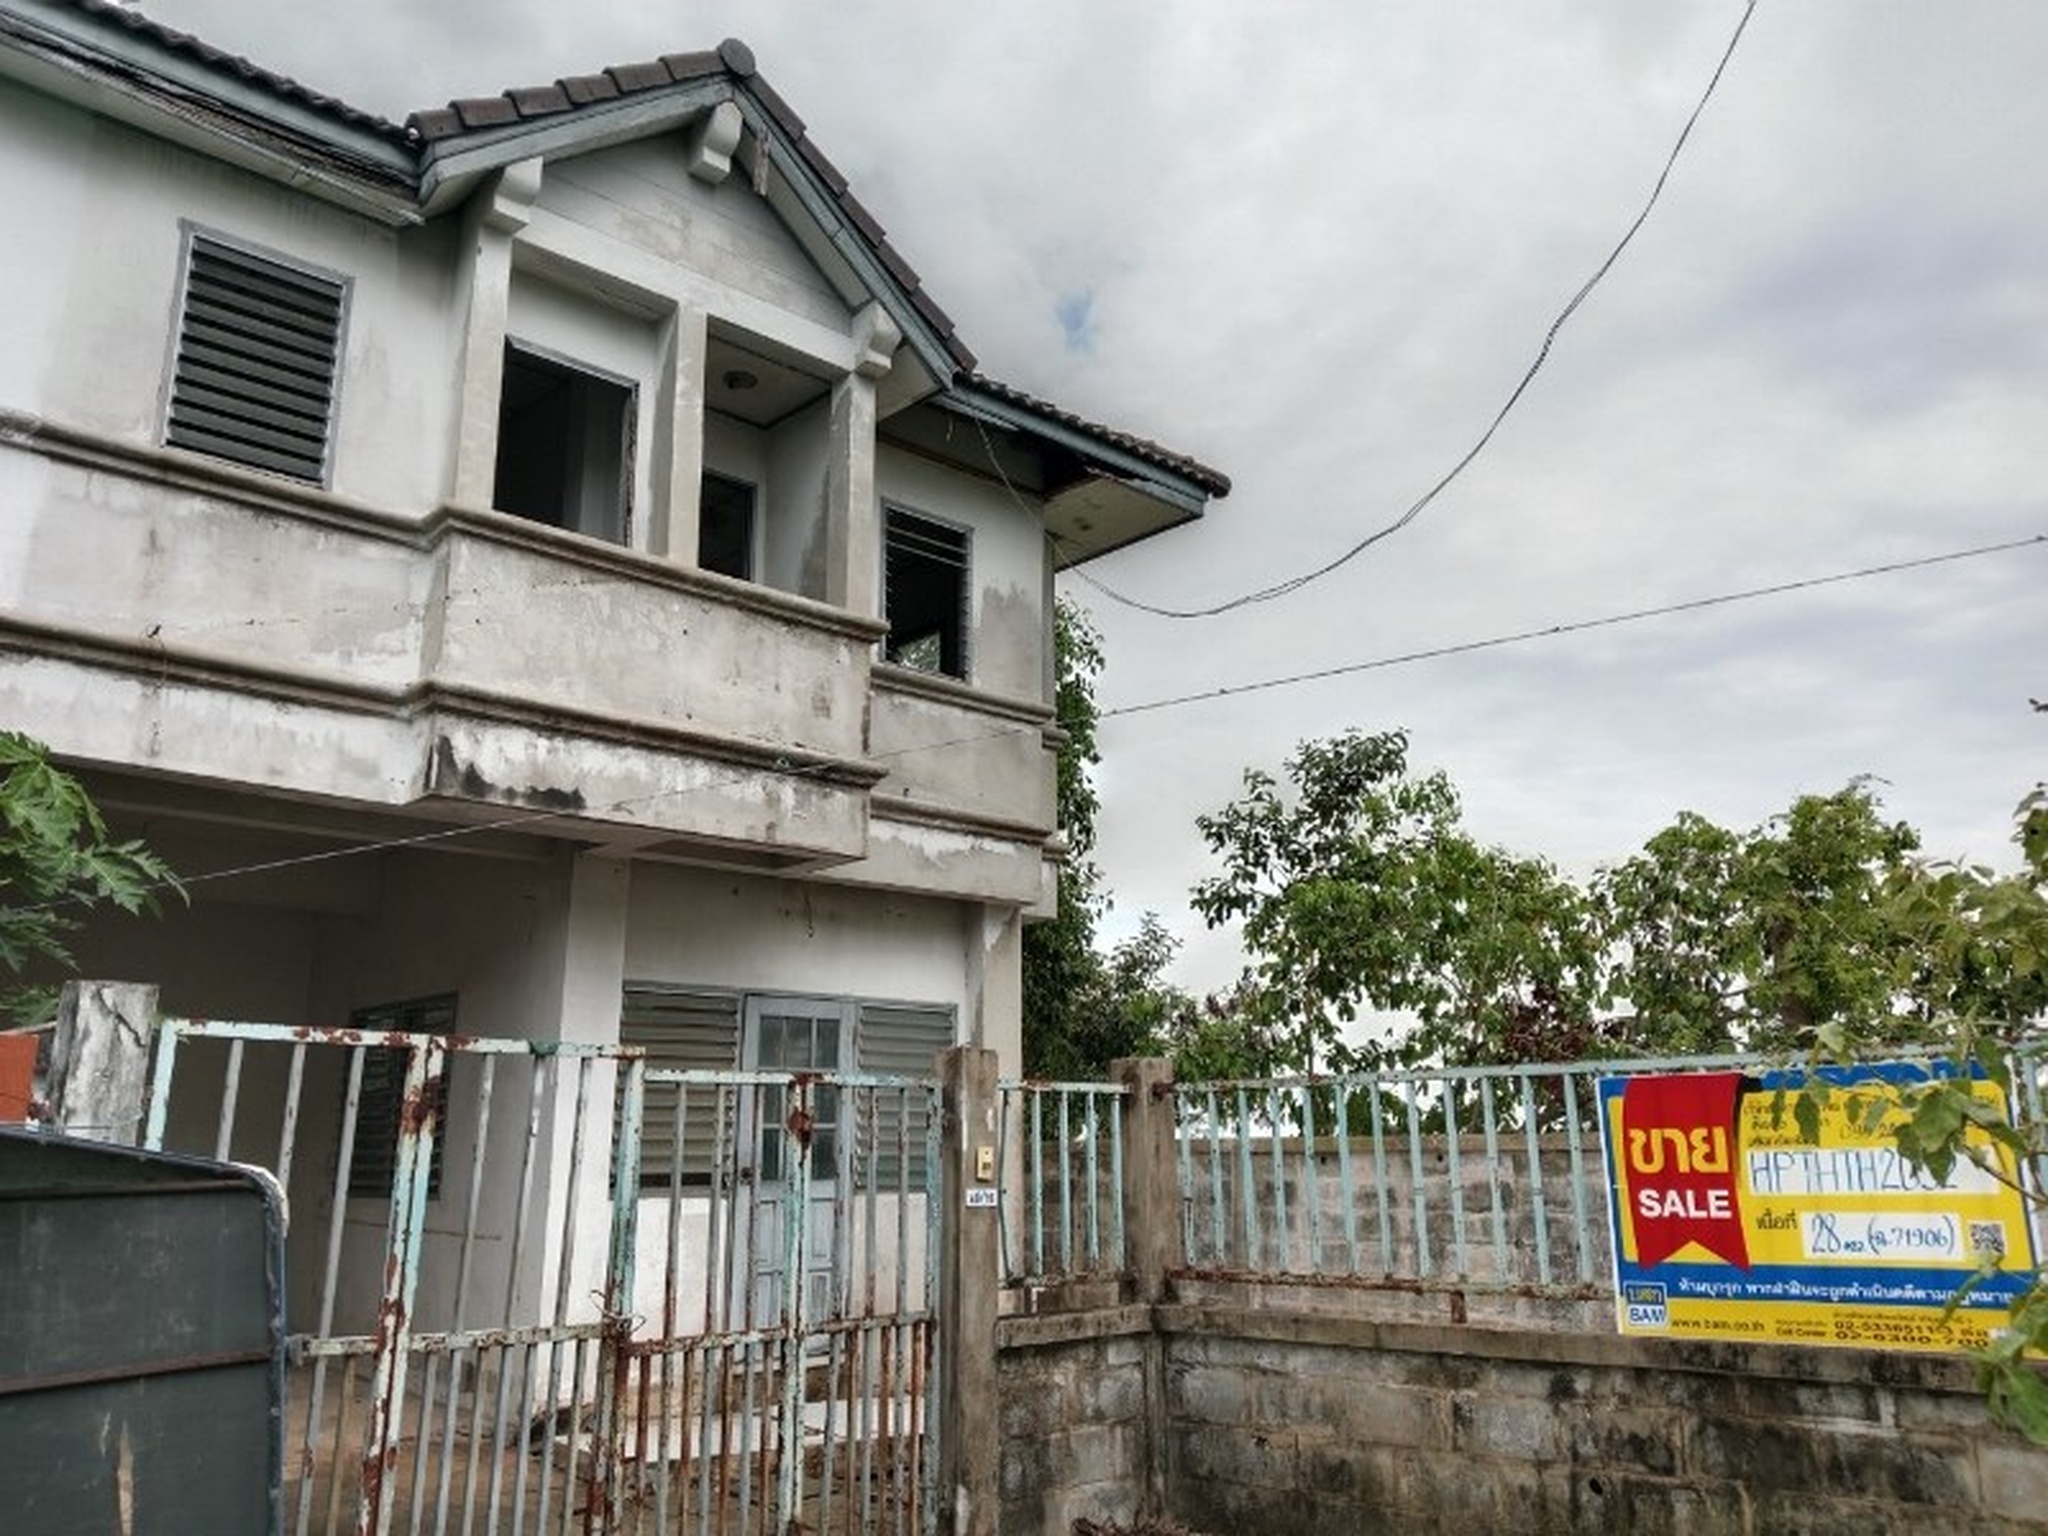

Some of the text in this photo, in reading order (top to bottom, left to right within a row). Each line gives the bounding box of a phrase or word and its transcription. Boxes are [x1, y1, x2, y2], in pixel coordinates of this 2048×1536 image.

[1628, 1126, 1729, 1174] ขาย
[1638, 1188, 1733, 1219] SALE
[1756, 1207, 1799, 1230] เนื้อที่
[1811, 1212, 1841, 1254] 28
[1629, 1306, 1665, 1323] BAM
